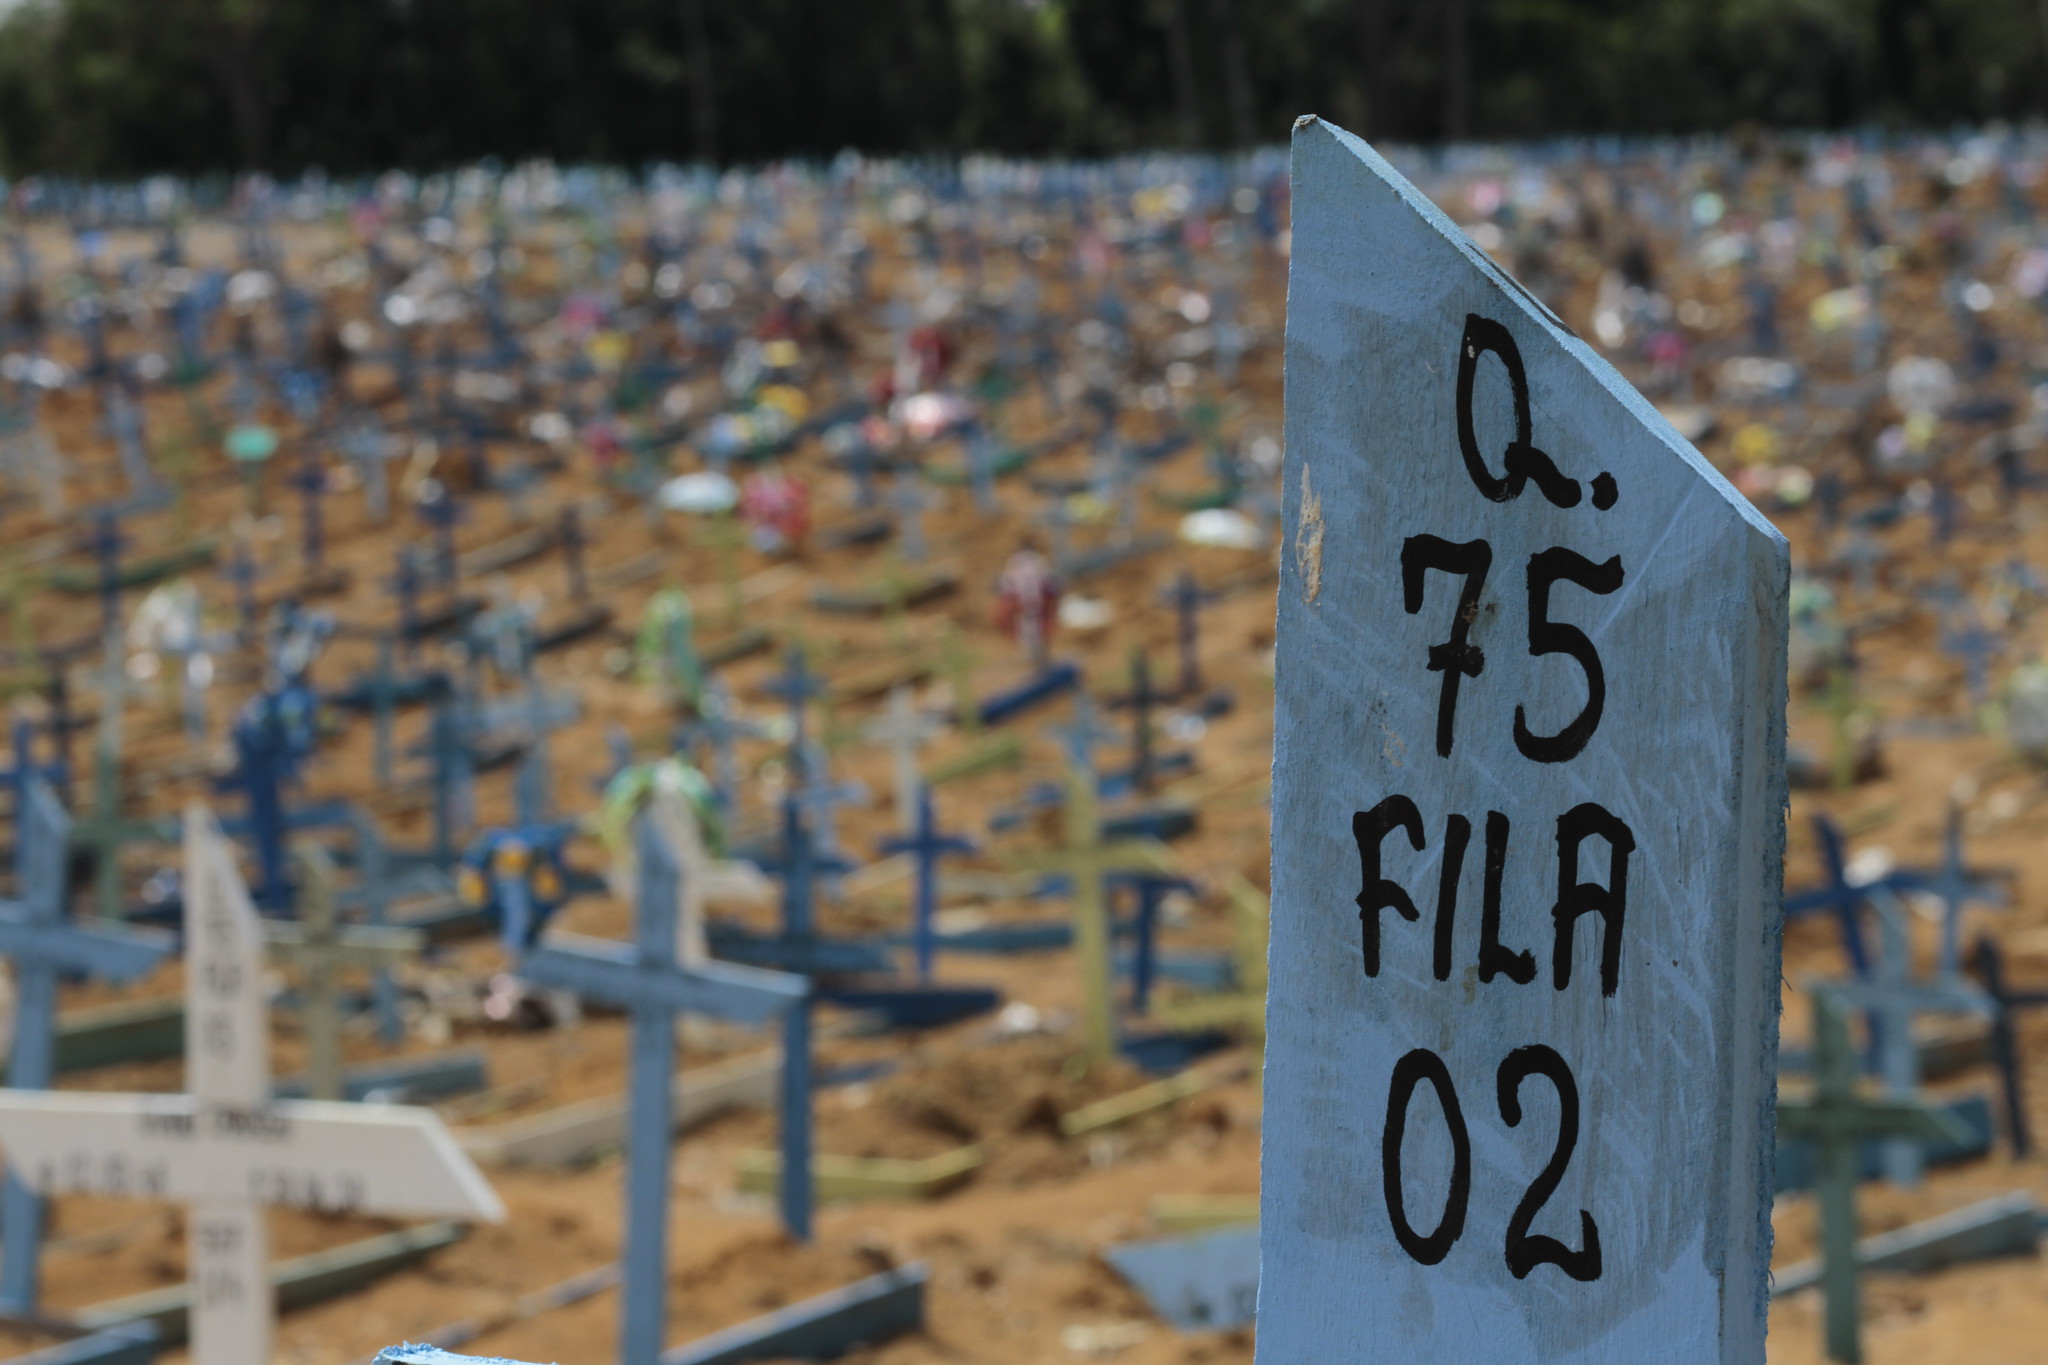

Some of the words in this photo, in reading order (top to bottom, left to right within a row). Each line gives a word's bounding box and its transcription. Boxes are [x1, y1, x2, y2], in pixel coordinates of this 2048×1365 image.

[1400, 533, 1625, 764] 75
[1352, 794, 1637, 999] FILA
[1381, 1043, 1603, 1282] 02
